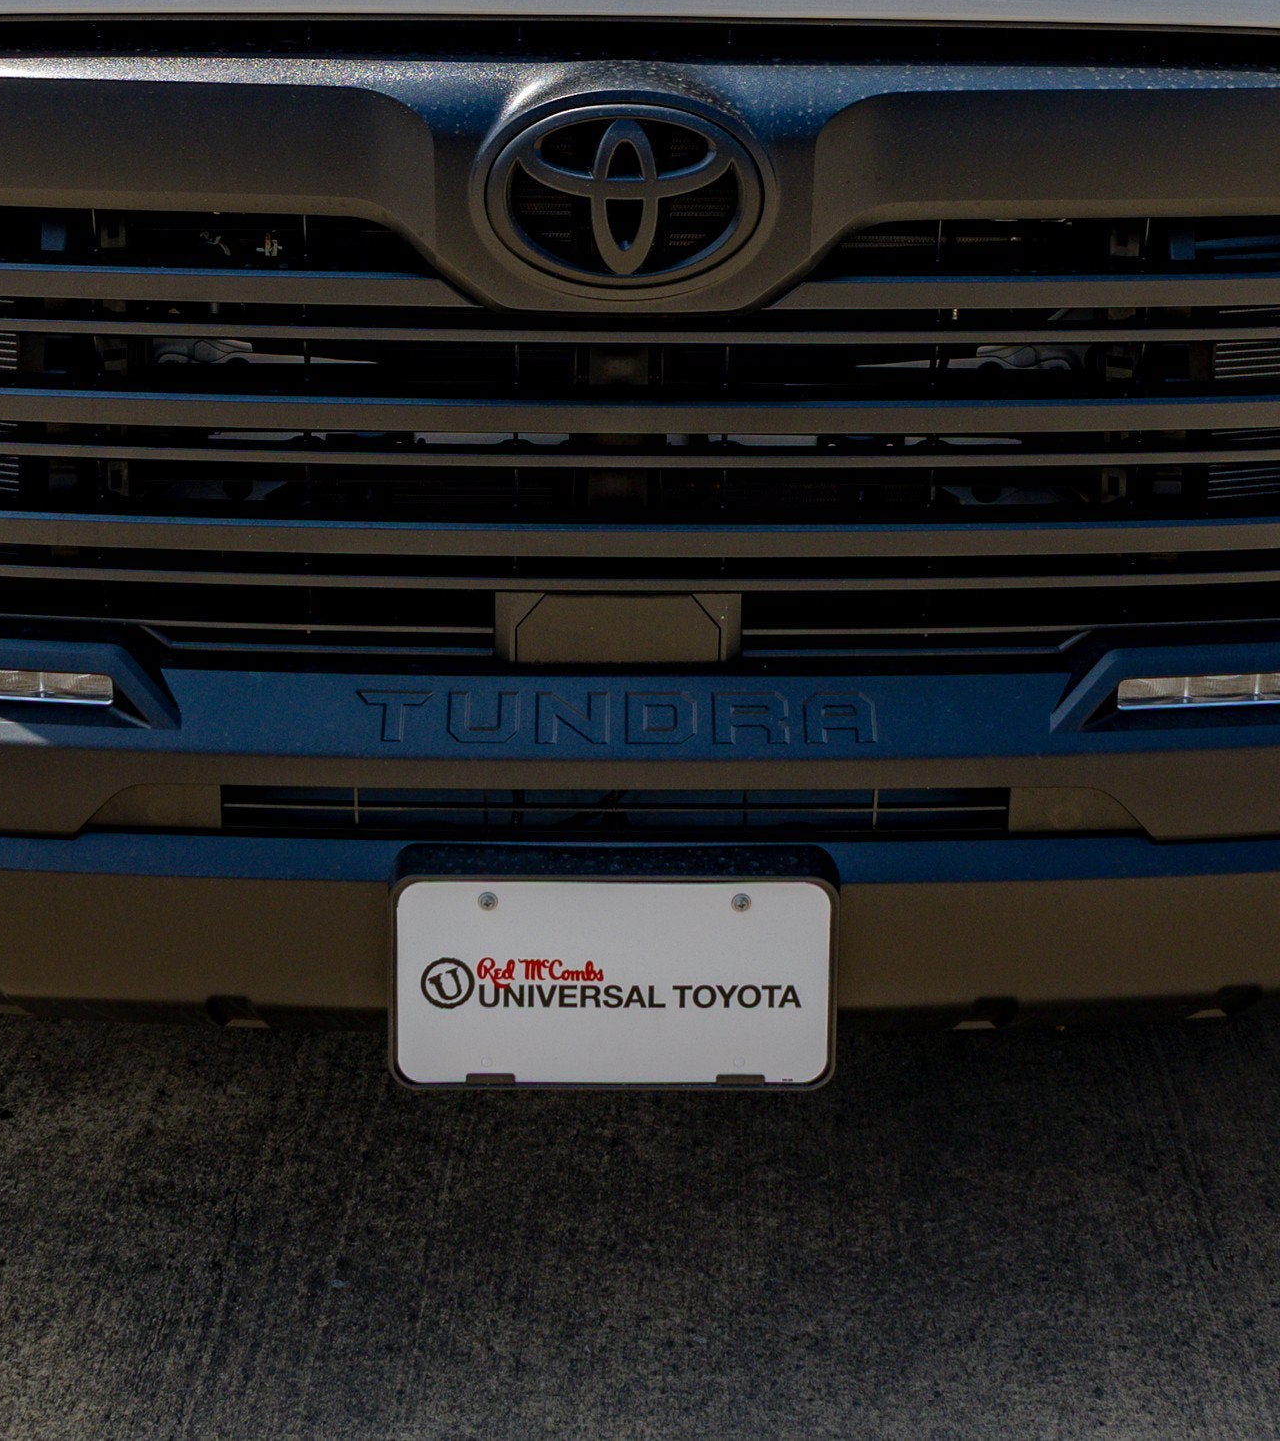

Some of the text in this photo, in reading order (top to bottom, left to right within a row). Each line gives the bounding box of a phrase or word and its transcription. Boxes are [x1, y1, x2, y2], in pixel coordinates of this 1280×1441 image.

[355, 689, 879, 746] TUNDRA
[476, 957, 604, 989] Red McCombs
[478, 984, 802, 1009] UNIVERSAL TOYOTA
